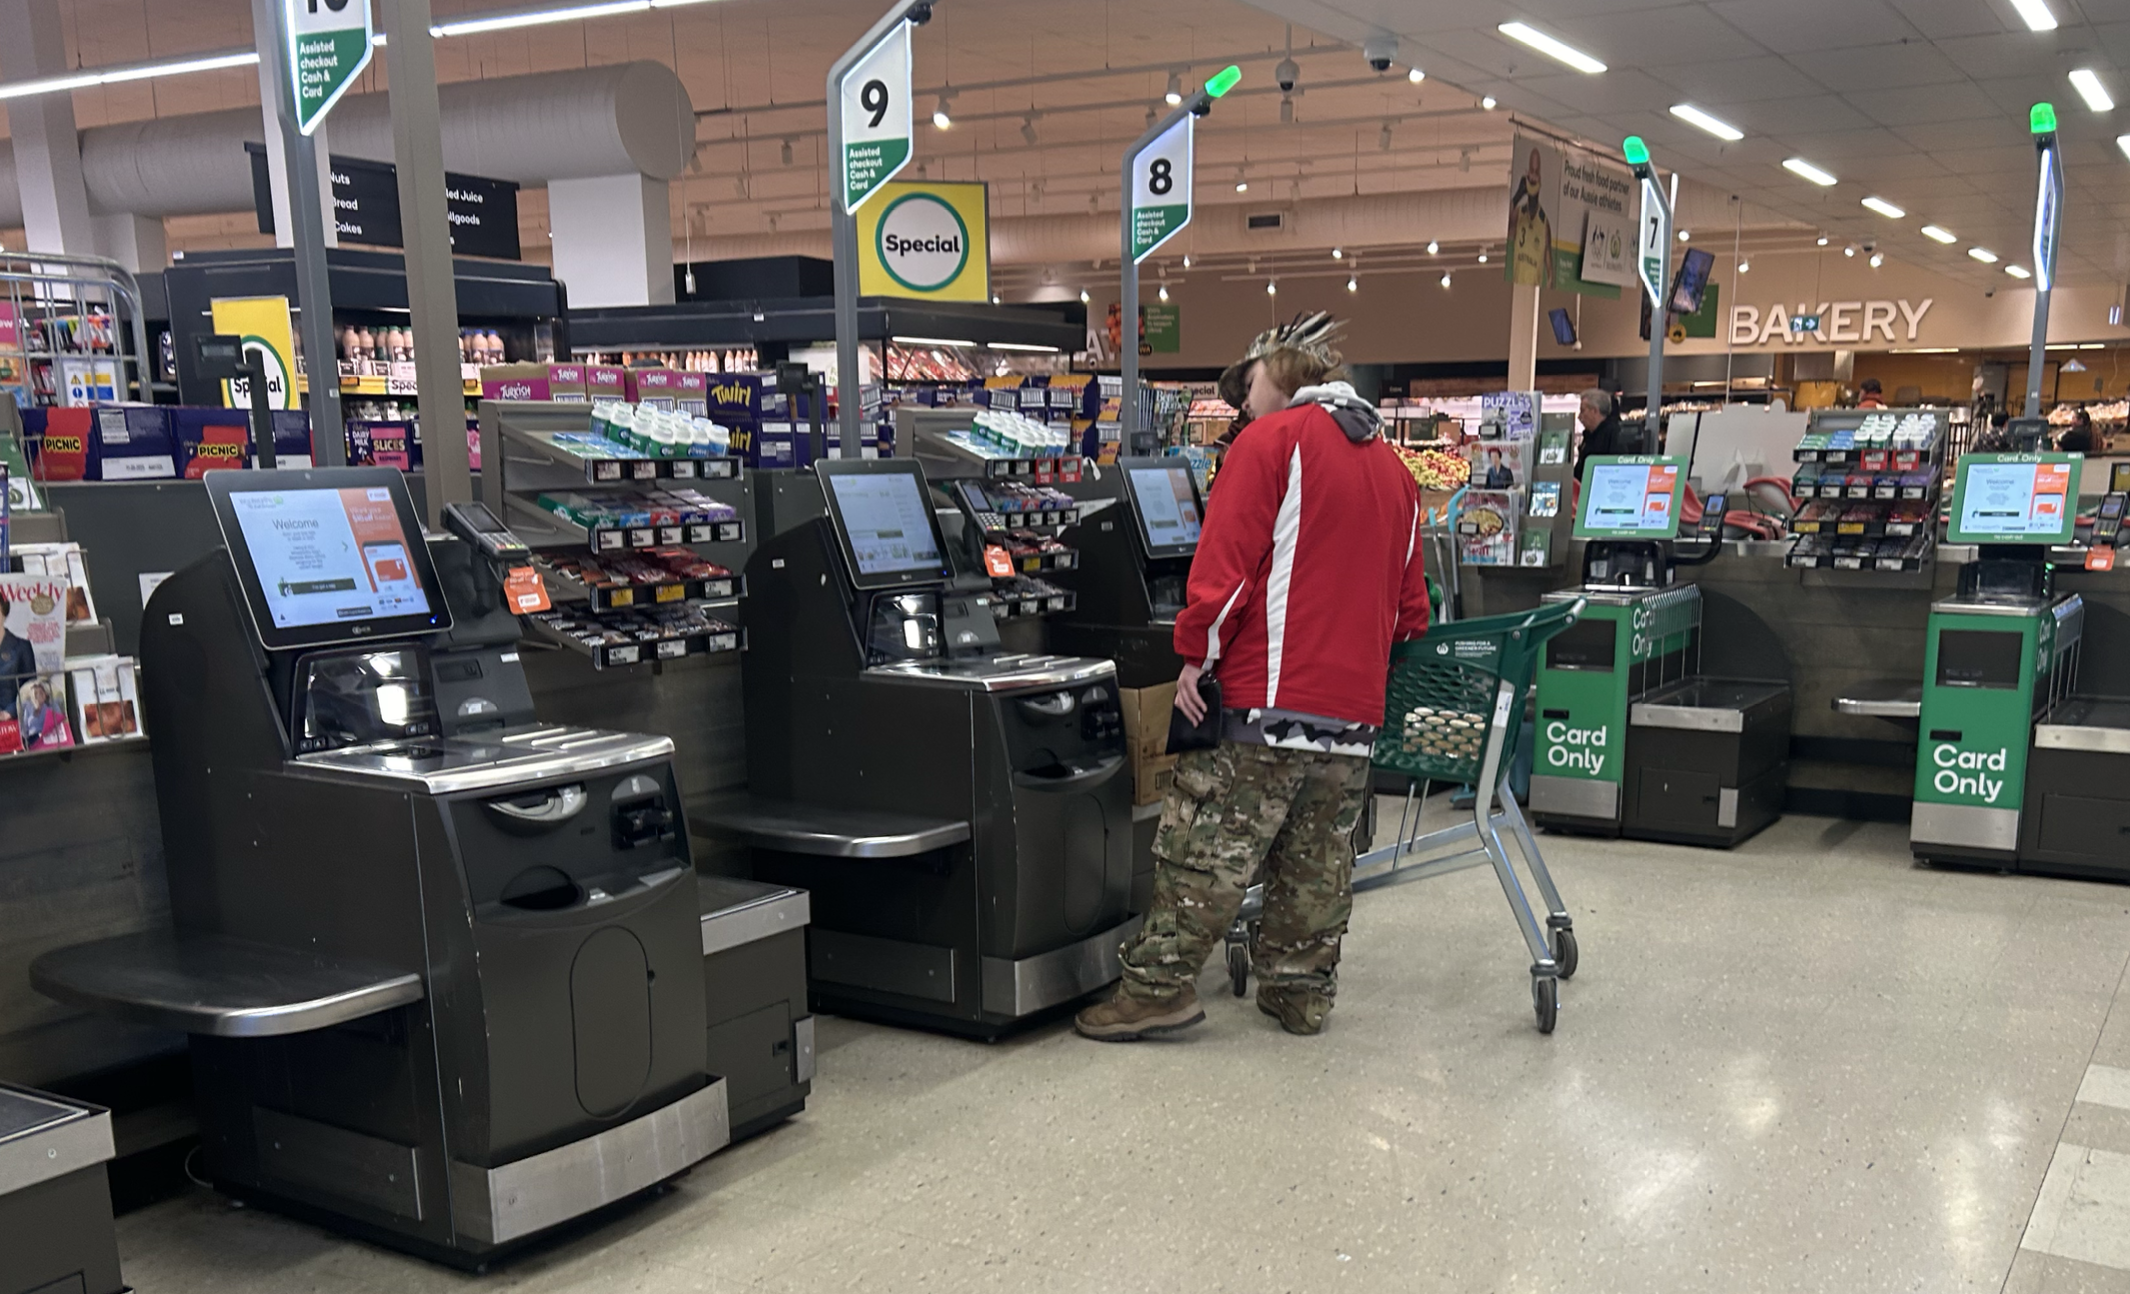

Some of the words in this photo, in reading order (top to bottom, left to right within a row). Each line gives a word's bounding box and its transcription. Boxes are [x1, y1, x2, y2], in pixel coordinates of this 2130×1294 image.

[300, 39, 335, 55] Assisted
[300, 55, 338, 69] checkout
[301, 70, 323, 84] Cash
[323, 69, 331, 83] &
[302, 85, 323, 98] Card
[861, 79, 888, 128] 9
[849, 146, 880, 158] Assisted
[849, 158, 883, 169] checkout
[850, 169, 869, 180] Cash
[869, 168, 876, 178] &
[1149, 158, 1172, 195] 8
[1564, 160, 1581, 178] Proud
[1582, 165, 1595, 183] fresh
[1596, 170, 1609, 189] food
[1609, 175, 1630, 196] partner
[850, 180, 869, 191] Card
[461, 190, 483, 203] Juice
[1563, 181, 1570, 196] of
[1569, 188, 1579, 201] our
[1580, 187, 1598, 206] Aussie
[1599, 195, 1622, 212] athletes
[333, 198, 359, 211] Bread
[1137, 210, 1164, 220] Assisted
[335, 222, 363, 235] Cakes
[1650, 216, 1658, 249] 7
[1519, 227, 1526, 247] 3
[885, 234, 960, 257] Special
[1728, 298, 1933, 345] BAKERY
[235, 376, 282, 398] Spial
[711, 379, 752, 408] Twirl
[1483, 396, 1531, 410] PUZZLES
[352, 430, 370, 439] DAIRY
[44, 437, 82, 452] PICNIC
[198, 444, 239, 458] PICNIC
[373, 439, 405, 452] SLICES
[1190, 455, 1212, 470] zzle
[1617, 456, 1636, 464] Card
[1637, 456, 1655, 465] Only
[1997, 454, 2018, 463] Card
[2021, 453, 2042, 463] Only
[272, 518, 320, 531] Welcome
[1, 582, 64, 605] Weekly
[2039, 618, 2051, 644] Card
[1632, 633, 1653, 658] Ony
[2036, 647, 2049, 674] Only
[1547, 721, 1607, 747] Card
[1547, 745, 1605, 776] Only
[1933, 743, 2007, 771] Card
[1934, 769, 2004, 803] Only
